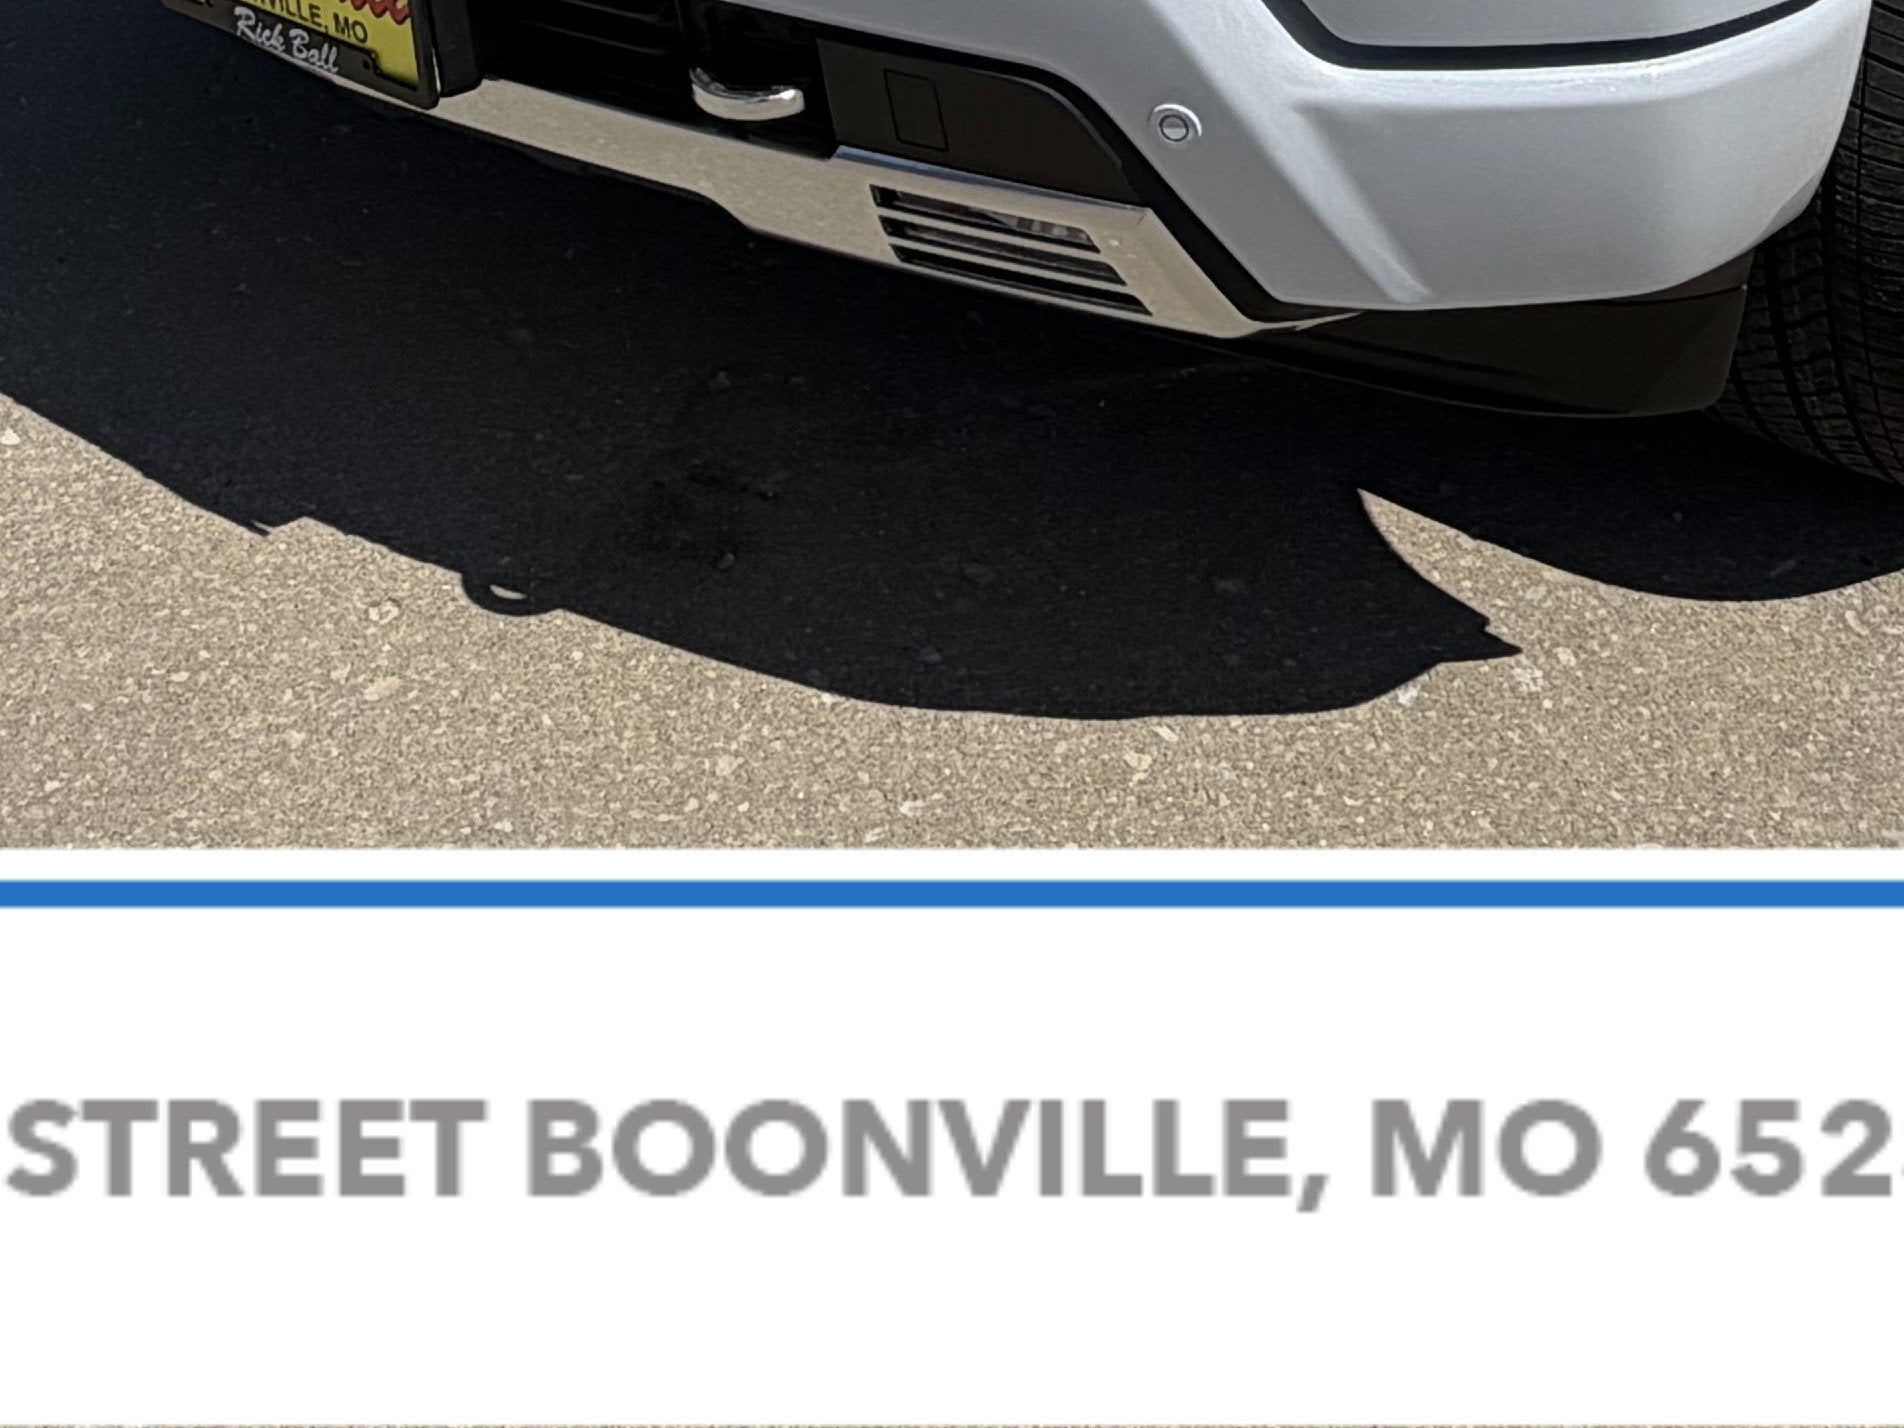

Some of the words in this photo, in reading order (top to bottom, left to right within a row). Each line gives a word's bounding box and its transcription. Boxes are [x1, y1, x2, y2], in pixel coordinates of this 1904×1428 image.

[233, 6, 286, 55] Rick
[288, 27, 339, 74] Ball
[333, 11, 369, 44] MO
